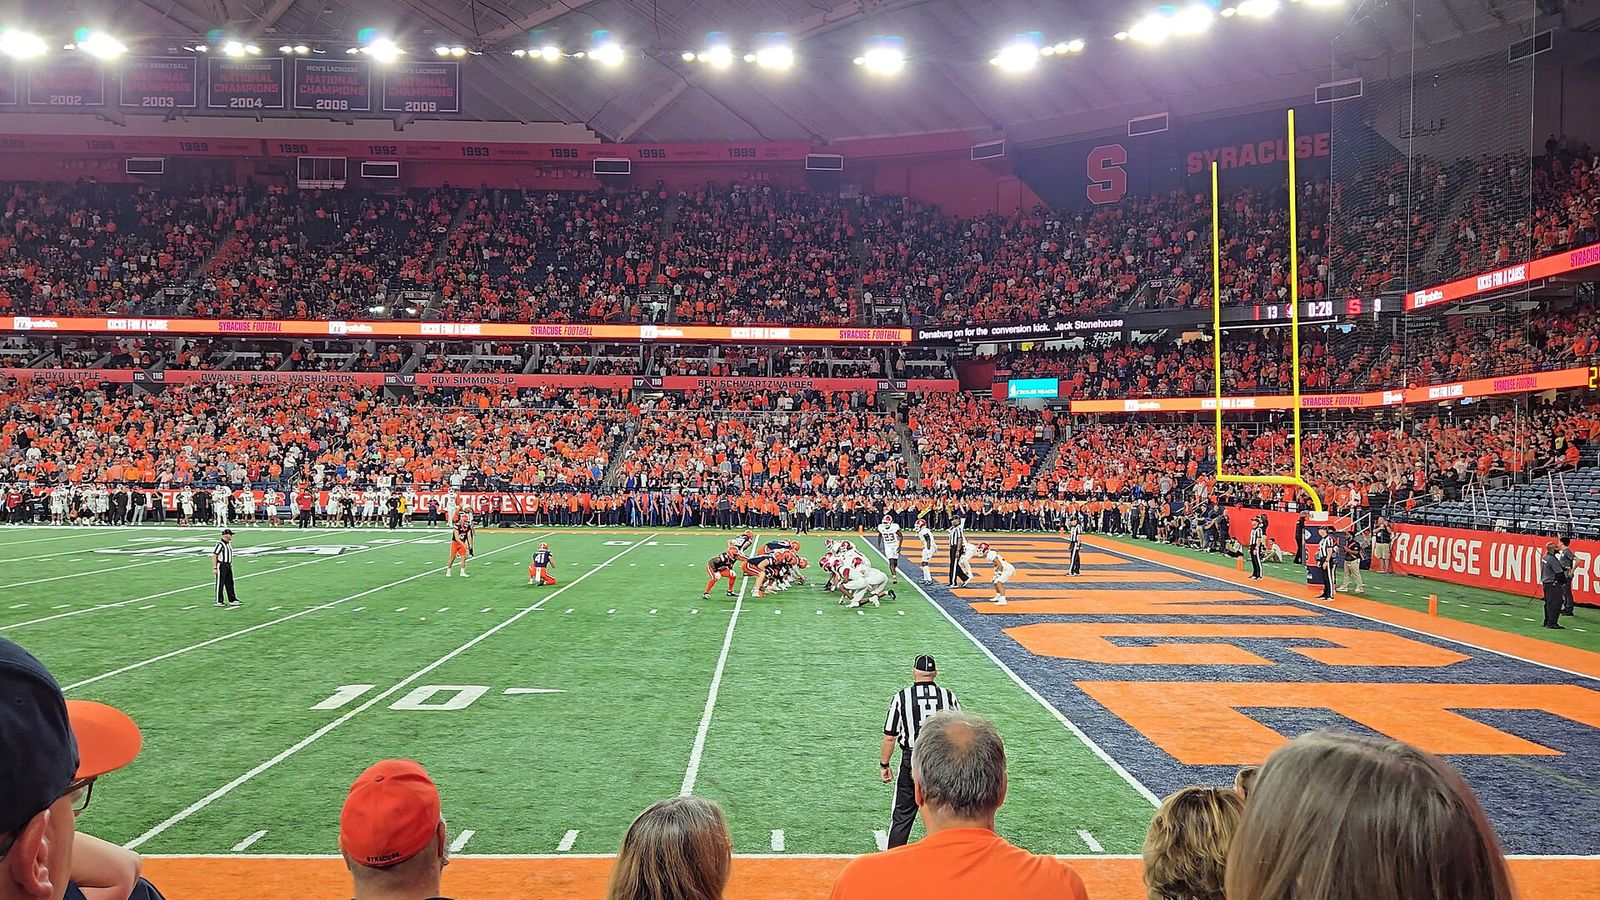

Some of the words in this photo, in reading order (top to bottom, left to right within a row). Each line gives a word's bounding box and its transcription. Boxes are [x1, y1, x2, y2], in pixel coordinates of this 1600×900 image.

[219, 73, 273, 83] NATIONAL
[304, 74, 358, 85] NATIONAL
[394, 77, 448, 87] NATIONAL
[214, 83, 279, 93] CHAMPIONS
[299, 85, 367, 96] CHAMPIONS
[388, 87, 453, 97] CHAMPIONS
[50, 95, 82, 106] 2002
[142, 96, 174, 107] 2003
[230, 97, 263, 108] 2004
[316, 99, 348, 110] 2008
[405, 101, 437, 112] 2009
[278, 144, 308, 154] 1990
[368, 145, 398, 155] 1992
[461, 147, 490, 157] 1993
[1187, 132, 1330, 174] SYRACUSE
[1087, 144, 1127, 205] S
[1570, 248, 1600, 268] SYRACUS
[1266, 305, 1278, 318] 13
[1308, 301, 1333, 317] 0:28
[218, 322, 250, 331] SYRACUSE
[252, 322, 282, 332] FOOTBALL
[530, 325, 562, 335] SYRACUSE
[563, 326, 593, 336] FOOTBALL
[954, 329, 963, 337] on
[964, 327, 975, 337] for
[976, 326, 988, 336] the
[991, 324, 1031, 335] conversion
[1033, 322, 1050, 332] kick.
[1054, 320, 1073, 331] Jack
[1074, 318, 1123, 330] Stonehouse
[839, 329, 870, 339] SYRACUSE
[872, 330, 901, 340] FOOTBALL
[68, 372, 100, 380] LITTLE
[152, 372, 164, 380] 116
[201, 373, 242, 382] DWAYNE
[289, 374, 356, 384] WASHINGTON
[404, 375, 414, 383] 117
[431, 376, 450, 384] ROY
[453, 376, 500, 385] SIMMONS
[633, 379, 644, 387] 117
[698, 379, 718, 388] BEN
[720, 380, 813, 389] SCHWARTZWALDER
[878, 382, 889, 390] 118
[896, 381, 907, 389] 119
[1493, 378, 1516, 391] SYRACUSE
[1516, 377, 1537, 390] FOOTBALL
[1302, 396, 1333, 406] SYRACUSE
[1335, 396, 1364, 406] FOOTBALL
[883, 532, 895, 544] 23
[534, 553, 545, 564] 41
[308, 684, 492, 711] 10
[917, 698, 939, 727] H
